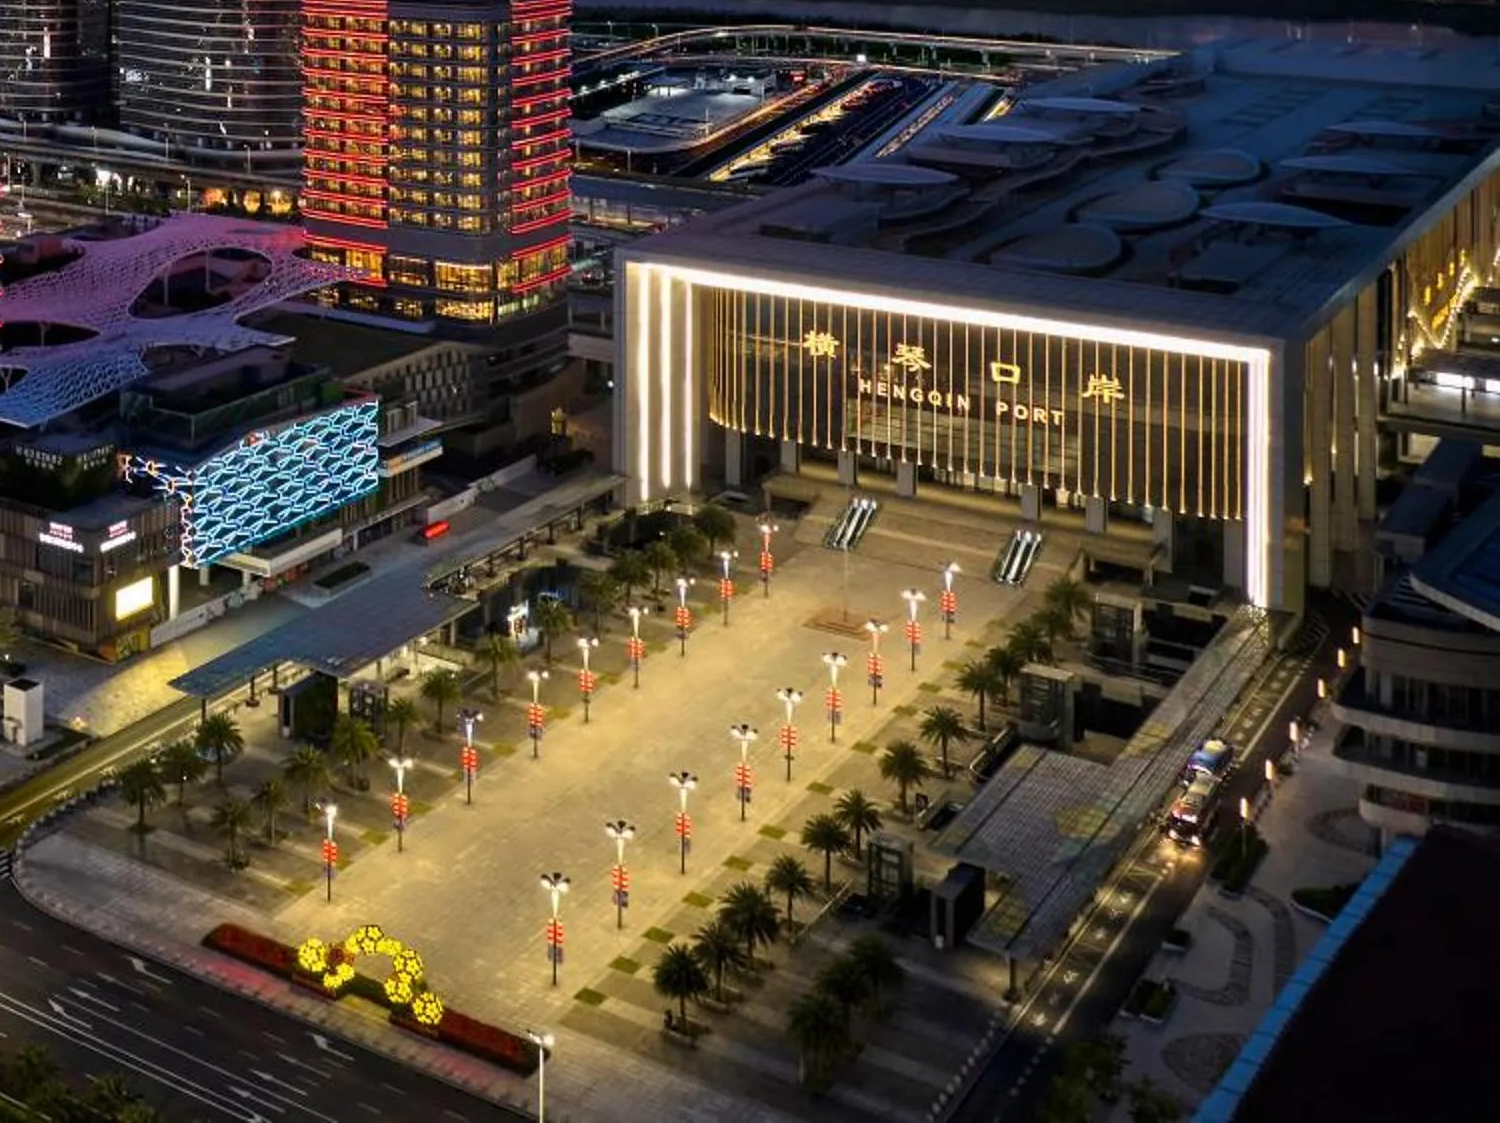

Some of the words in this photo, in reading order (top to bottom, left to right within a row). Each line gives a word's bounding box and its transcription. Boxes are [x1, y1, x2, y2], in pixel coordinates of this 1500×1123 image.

[803, 330, 1125, 404] 横琴口岸
[859, 378, 971, 412] HENGQIN
[995, 400, 1064, 426] PORT
